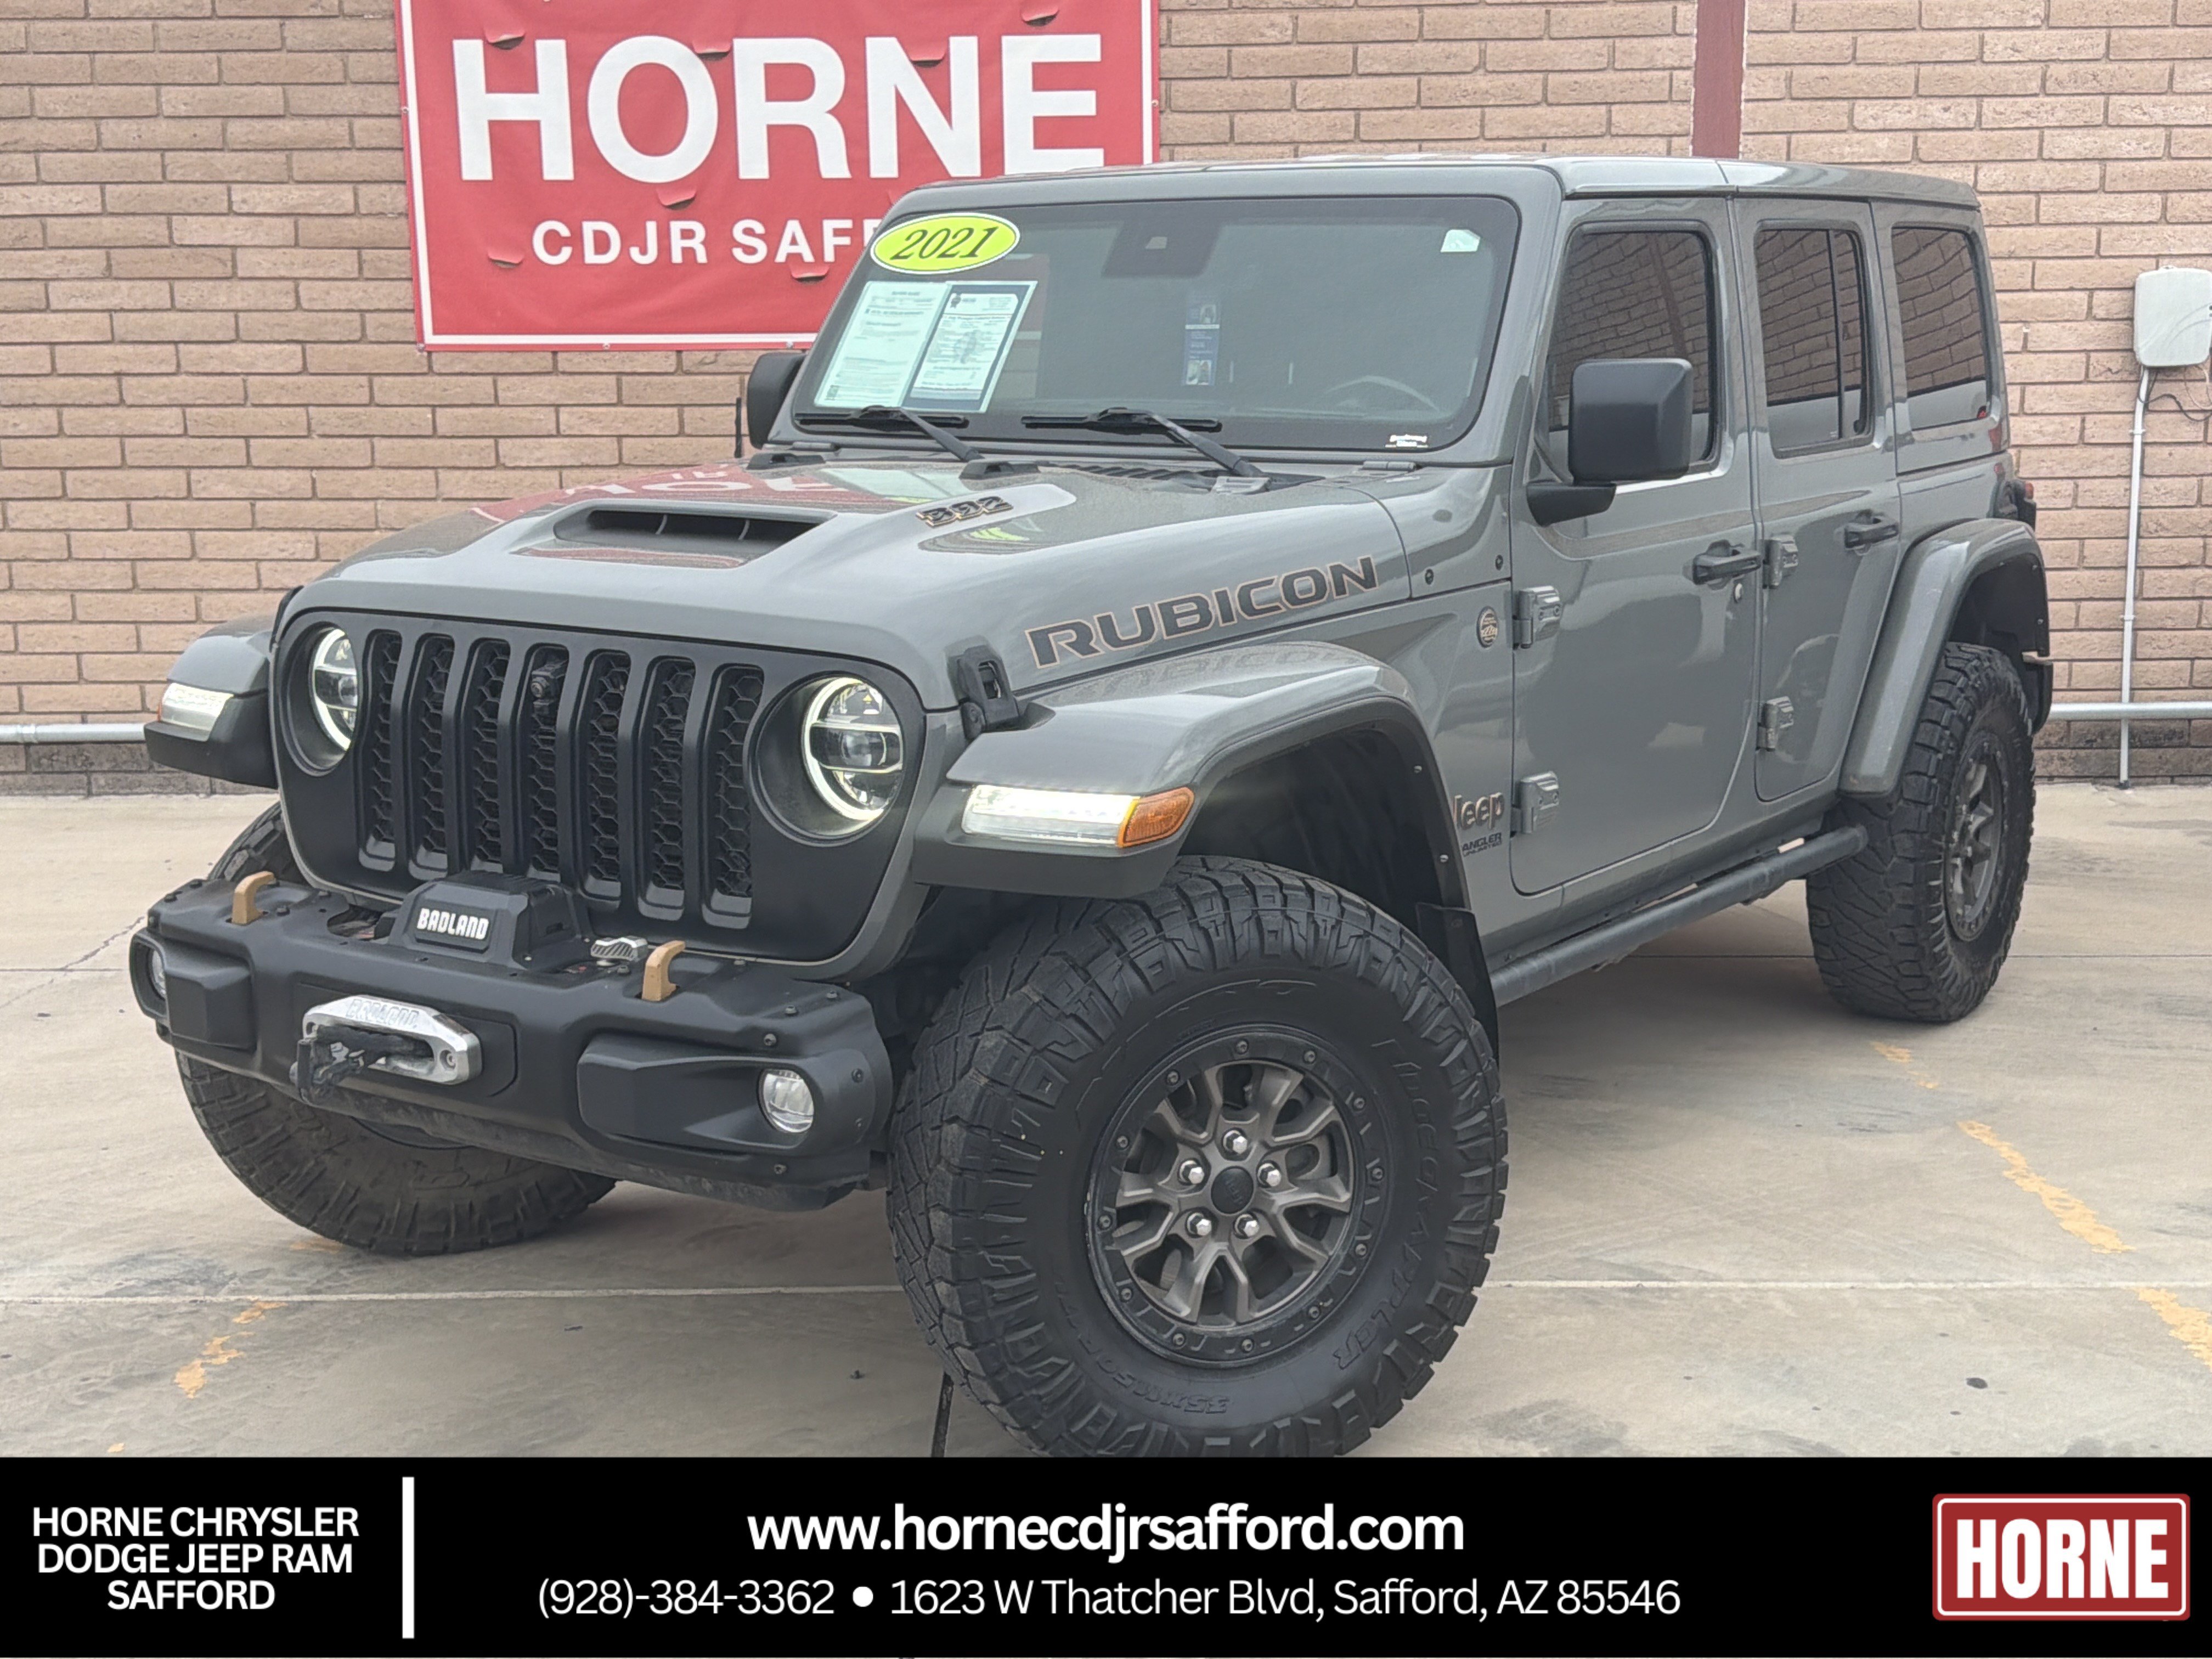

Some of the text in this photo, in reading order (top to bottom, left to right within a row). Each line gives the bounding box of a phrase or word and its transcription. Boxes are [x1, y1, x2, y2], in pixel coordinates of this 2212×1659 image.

[452, 33, 1106, 184] HORNE
[532, 219, 708, 266] CDJR
[890, 225, 1000, 261] 2021
[1024, 555, 1380, 669] RUBICON
[1453, 792, 1505, 830] Jeep
[1462, 831, 1502, 851] ANGLER
[416, 907, 490, 940] BADLAND
